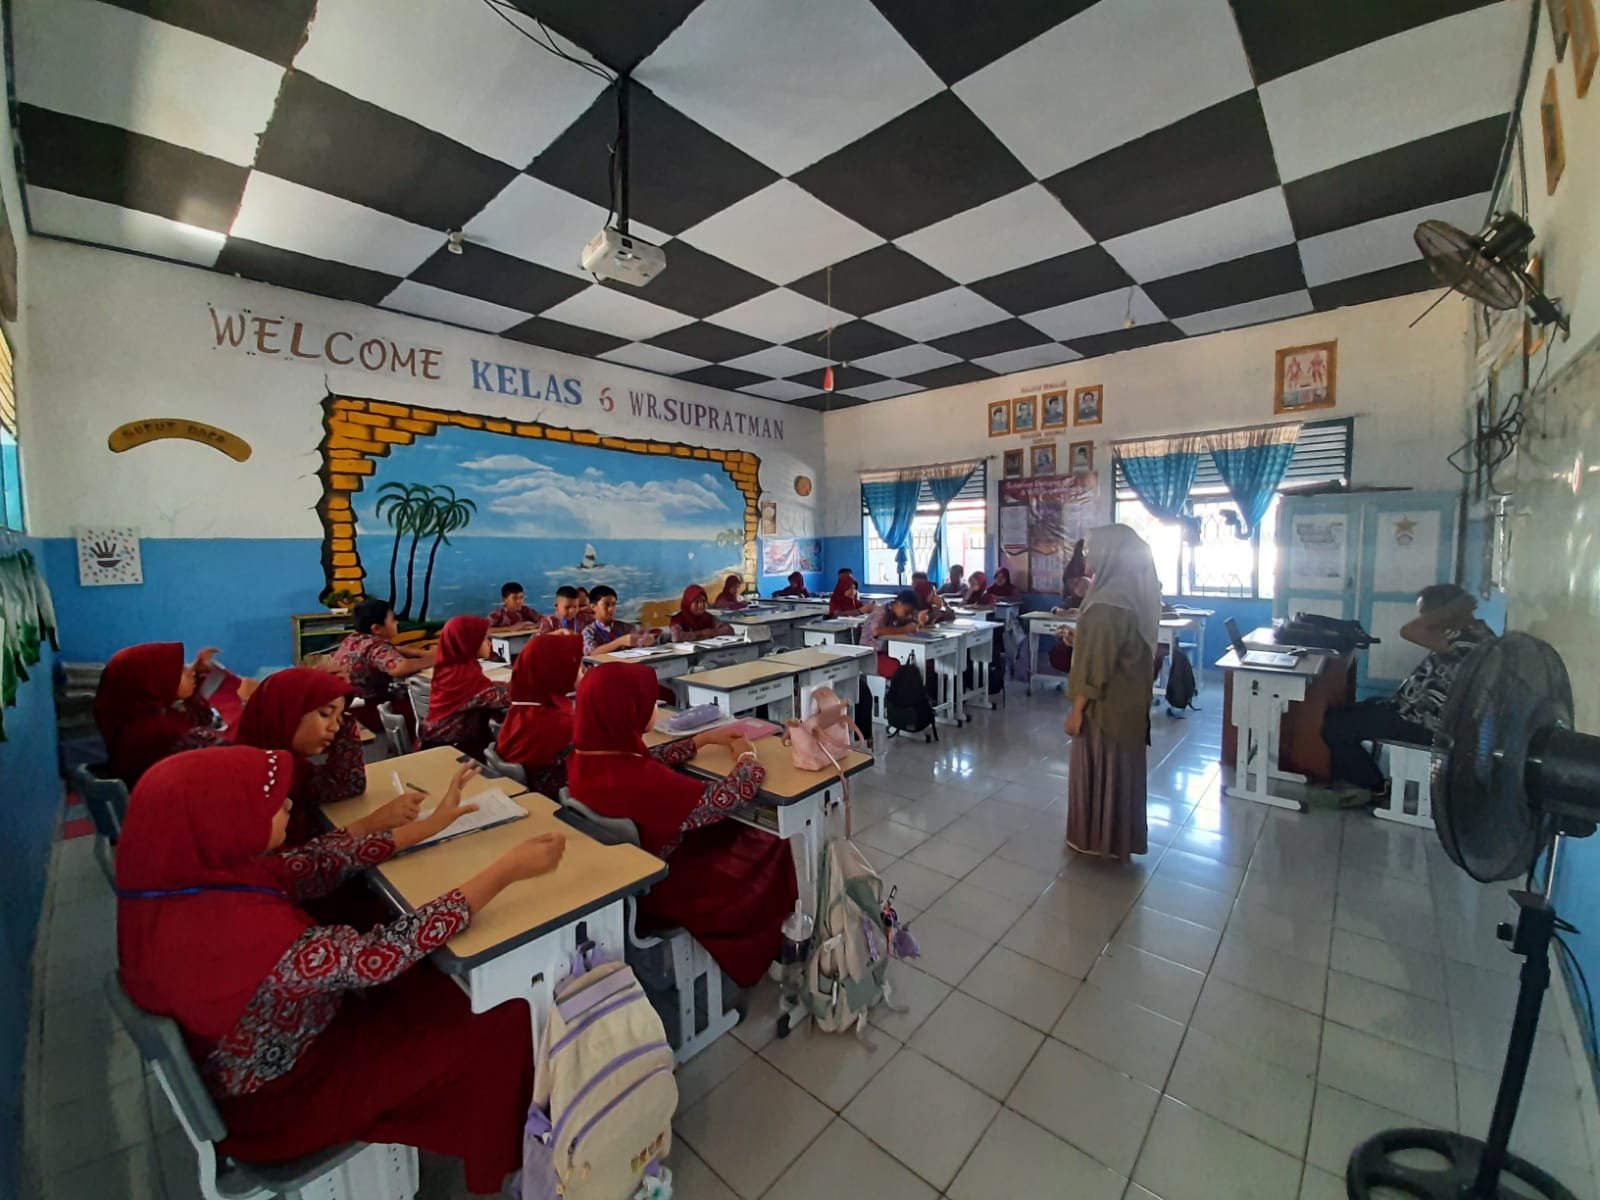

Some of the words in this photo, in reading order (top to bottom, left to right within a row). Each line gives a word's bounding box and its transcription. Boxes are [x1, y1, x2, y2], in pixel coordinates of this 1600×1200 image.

[209, 306, 443, 380] WELCOME
[470, 357, 583, 406] KELAS
[599, 386, 615, 413] 6
[628, 390, 785, 440] WR.SUPRATMAN
